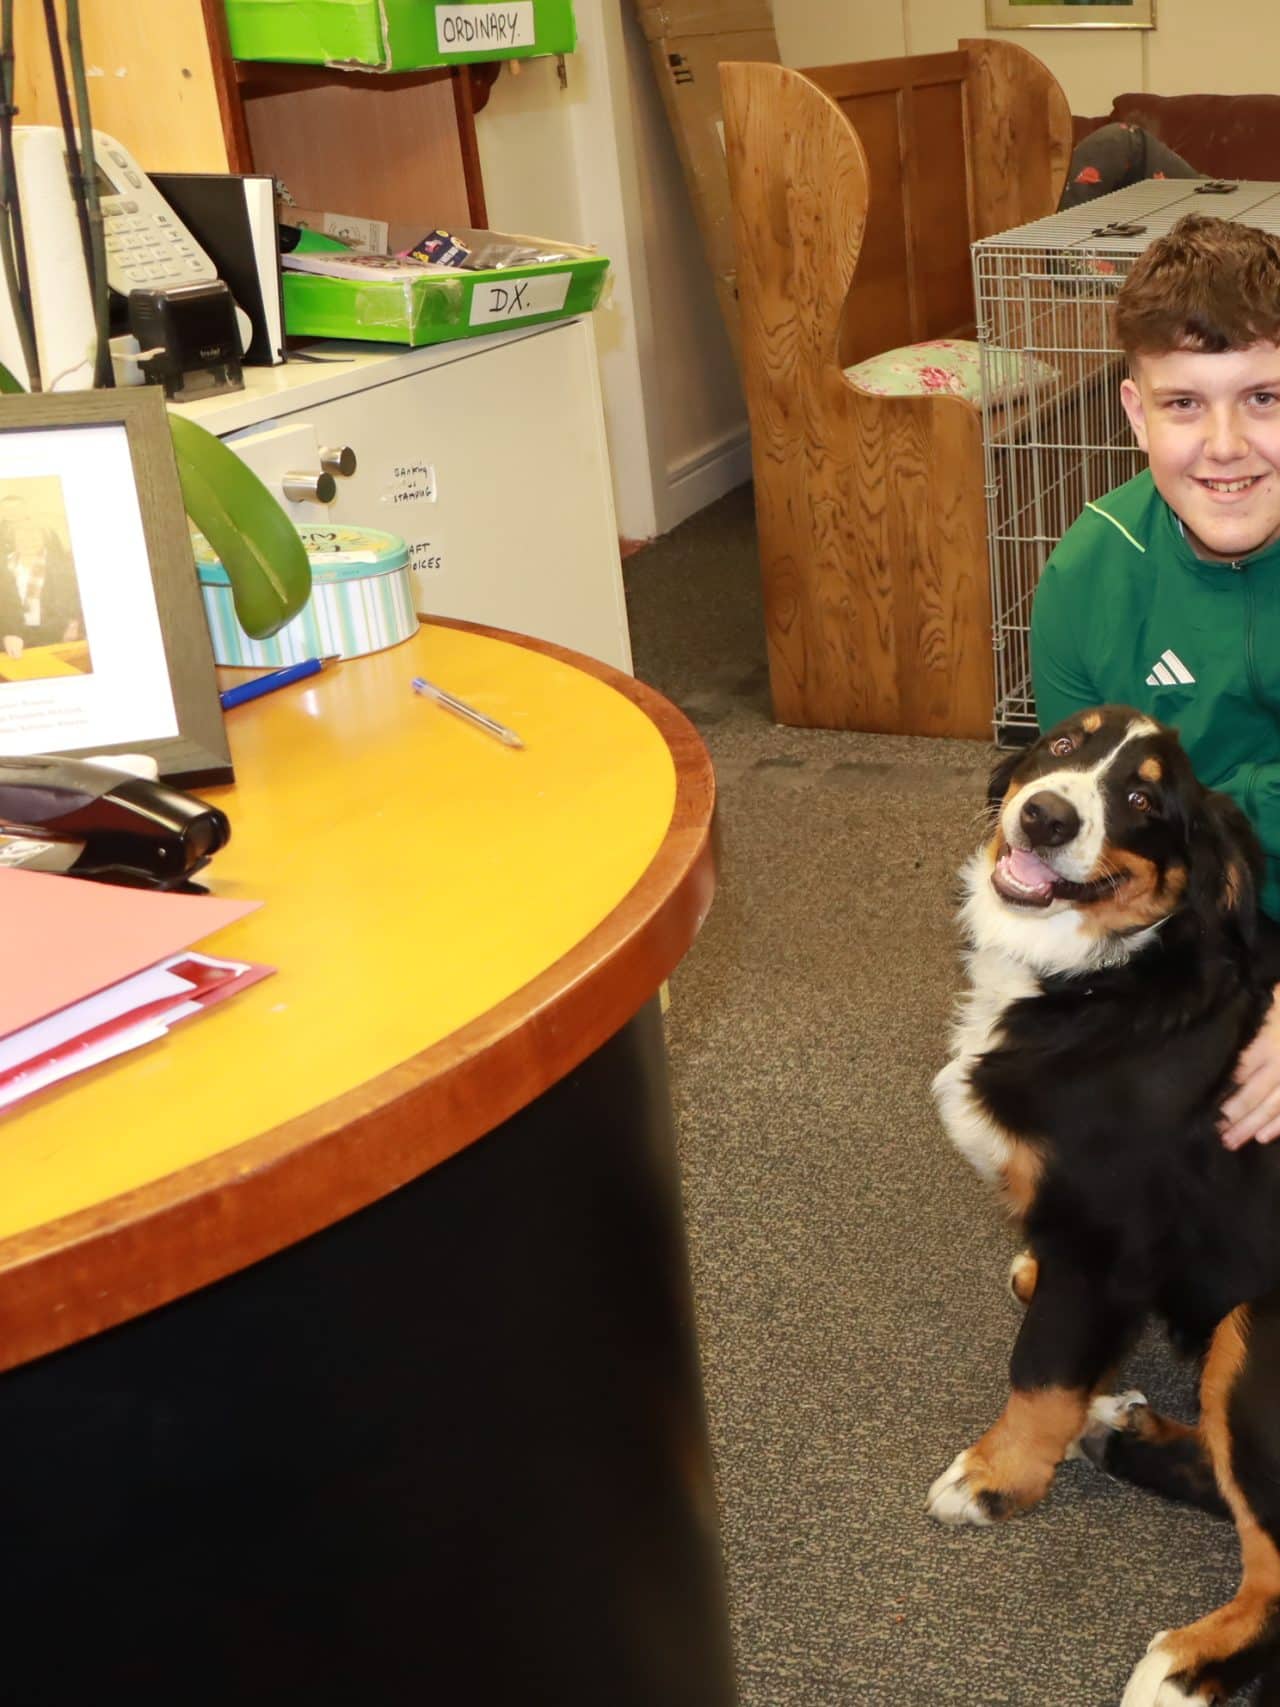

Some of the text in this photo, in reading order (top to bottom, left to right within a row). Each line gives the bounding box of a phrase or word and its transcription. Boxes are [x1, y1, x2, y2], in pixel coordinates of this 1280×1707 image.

[443, 12, 521, 43] ORDINARY.
[489, 282, 530, 315] DX.
[409, 543, 430, 554] AFT
[412, 557, 441, 570] OICES
